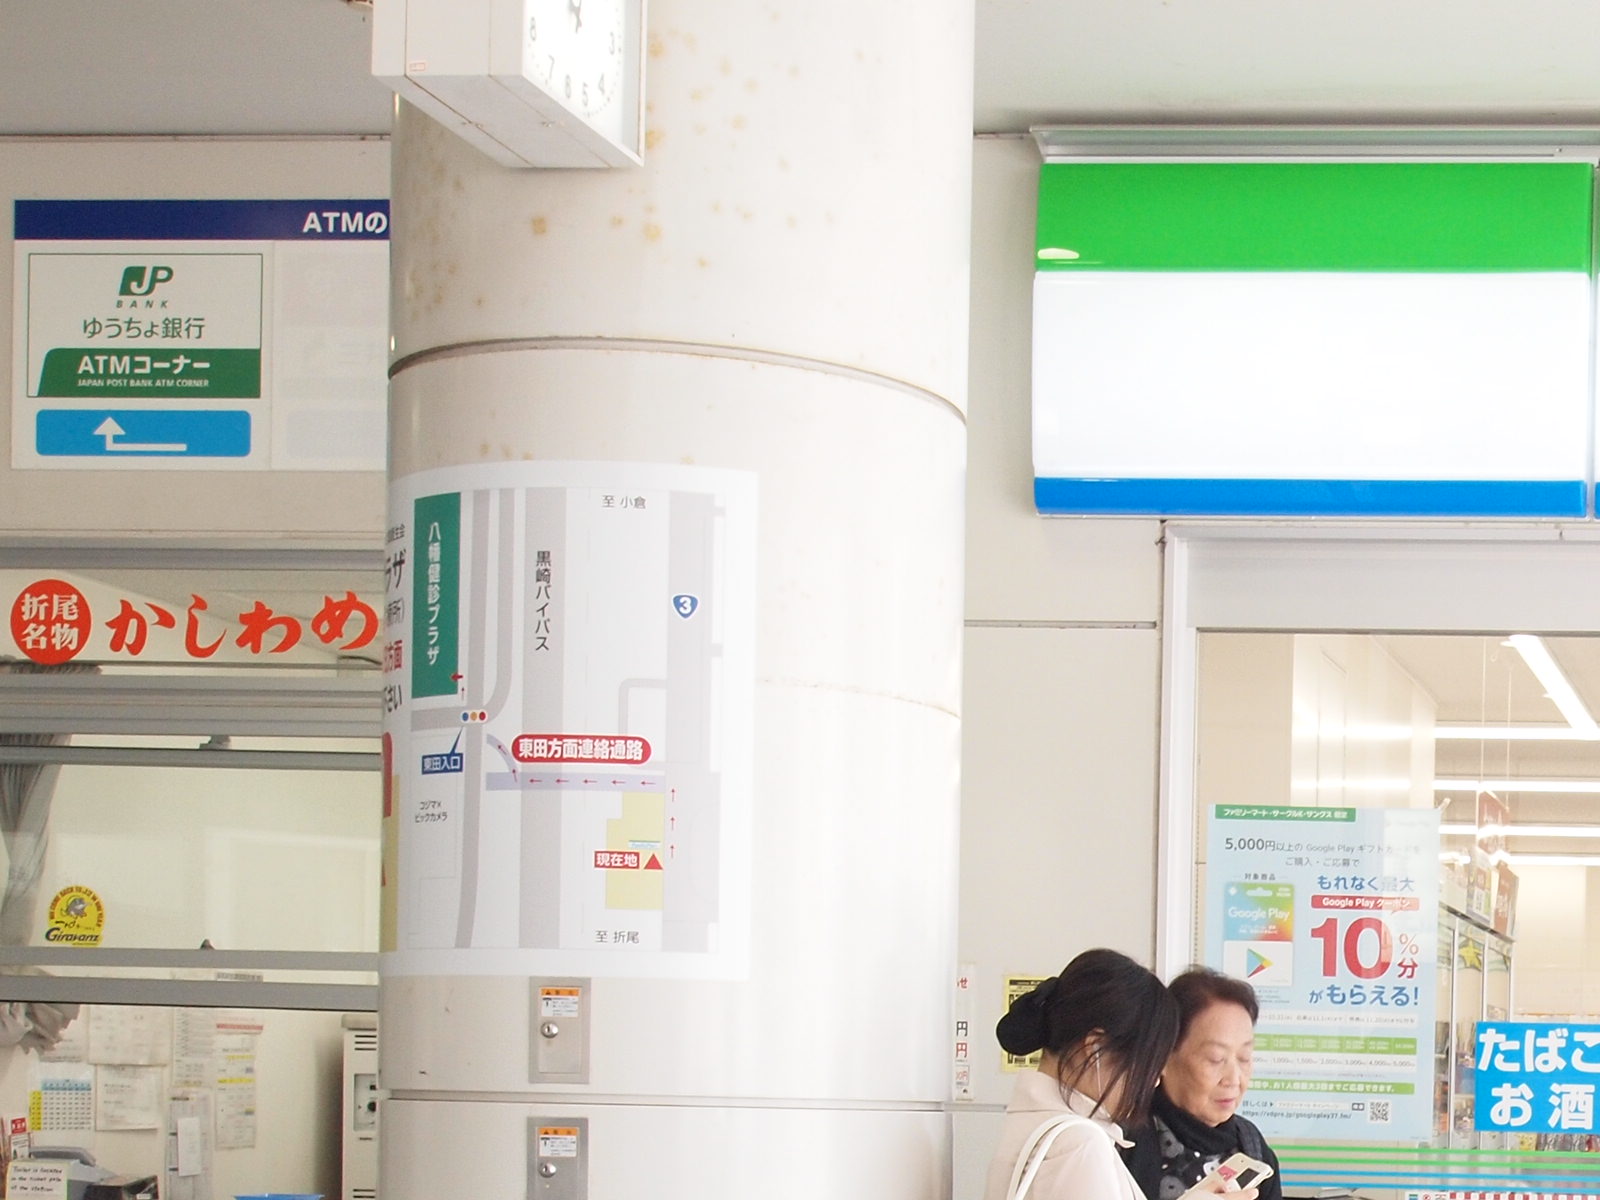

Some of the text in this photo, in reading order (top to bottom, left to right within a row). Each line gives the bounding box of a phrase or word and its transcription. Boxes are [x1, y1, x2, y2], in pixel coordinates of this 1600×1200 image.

[303, 211, 387, 234] ATMの
[116, 300, 168, 308] BANK
[83, 317, 205, 340] ゆうちょ銀行
[78, 355, 210, 374] ATMコーナー
[78, 378, 209, 387] JAPAN POST BANK ATM CORNER
[620, 496, 646, 509] 小倉
[21, 594, 79, 620] 折尾
[535, 551, 551, 651] 黒崎バイパス
[679, 597, 691, 614] 3
[105, 591, 378, 658] かしわめ
[21, 623, 79, 650] 名物
[518, 738, 643, 760] 東田方面連絡通路
[423, 756, 461, 771] 東田入口
[415, 812, 448, 823] ビックカメラ
[1225, 838, 1303, 852] 5,000円以上の
[1306, 844, 1336, 853] Google
[1337, 845, 1354, 854] Play
[596, 853, 638, 867] 現在地
[1317, 875, 1415, 892] もれなく最大
[1322, 897, 1354, 908] Google
[1355, 898, 1375, 908] Play
[1228, 908, 1290, 922] Google Play
[613, 931, 639, 944] 折尾
[1311, 917, 1393, 979] 10
[1309, 984, 1419, 1006] がもらえる!
[1242, 1099, 1268, 1107] 詳しくは
[1490, 1083, 1595, 1130] お酒
